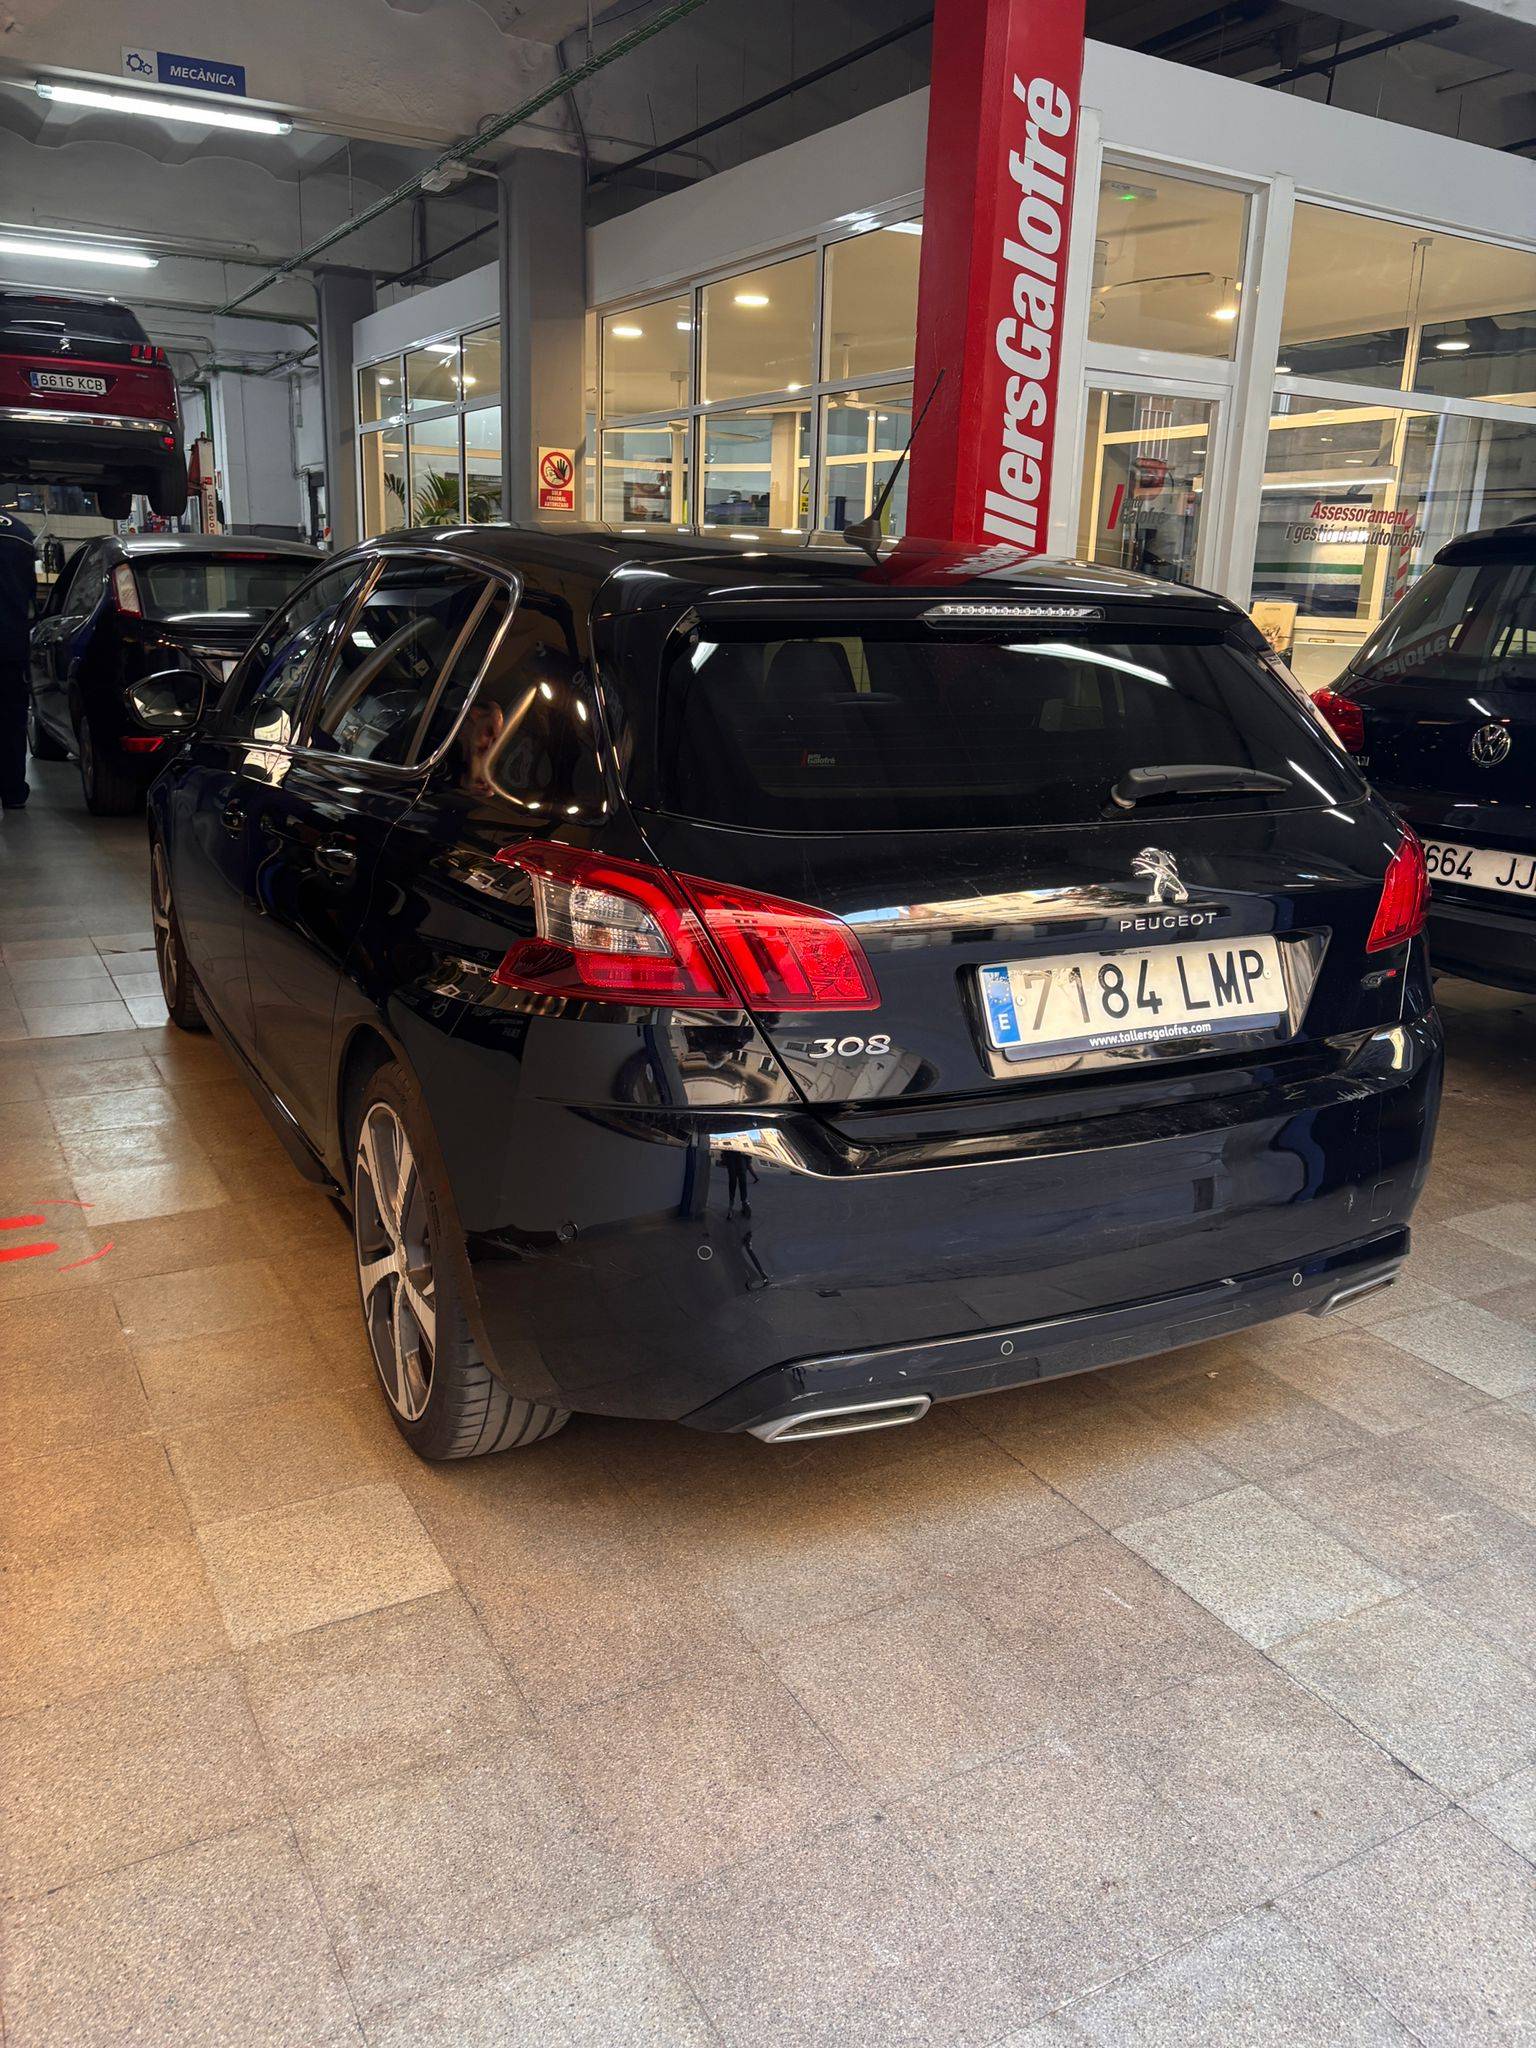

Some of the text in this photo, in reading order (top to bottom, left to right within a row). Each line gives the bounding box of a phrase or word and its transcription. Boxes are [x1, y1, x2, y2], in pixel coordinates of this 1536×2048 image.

[170, 65, 236, 86] MECÀNICA
[983, 73, 1073, 551] llersGalofré
[40, 374, 104, 391] 6616 KCB
[1311, 500, 1409, 525] Assessorament
[1422, 844, 1536, 890] 664 JJ
[1119, 912, 1218, 932] PEUGEOT
[1023, 949, 1265, 1031] 7184 LMP
[997, 1013, 1012, 1031] E
[808, 1034, 892, 1059] 308
[1088, 1022, 1212, 1048] www.tallersgalofre.com
